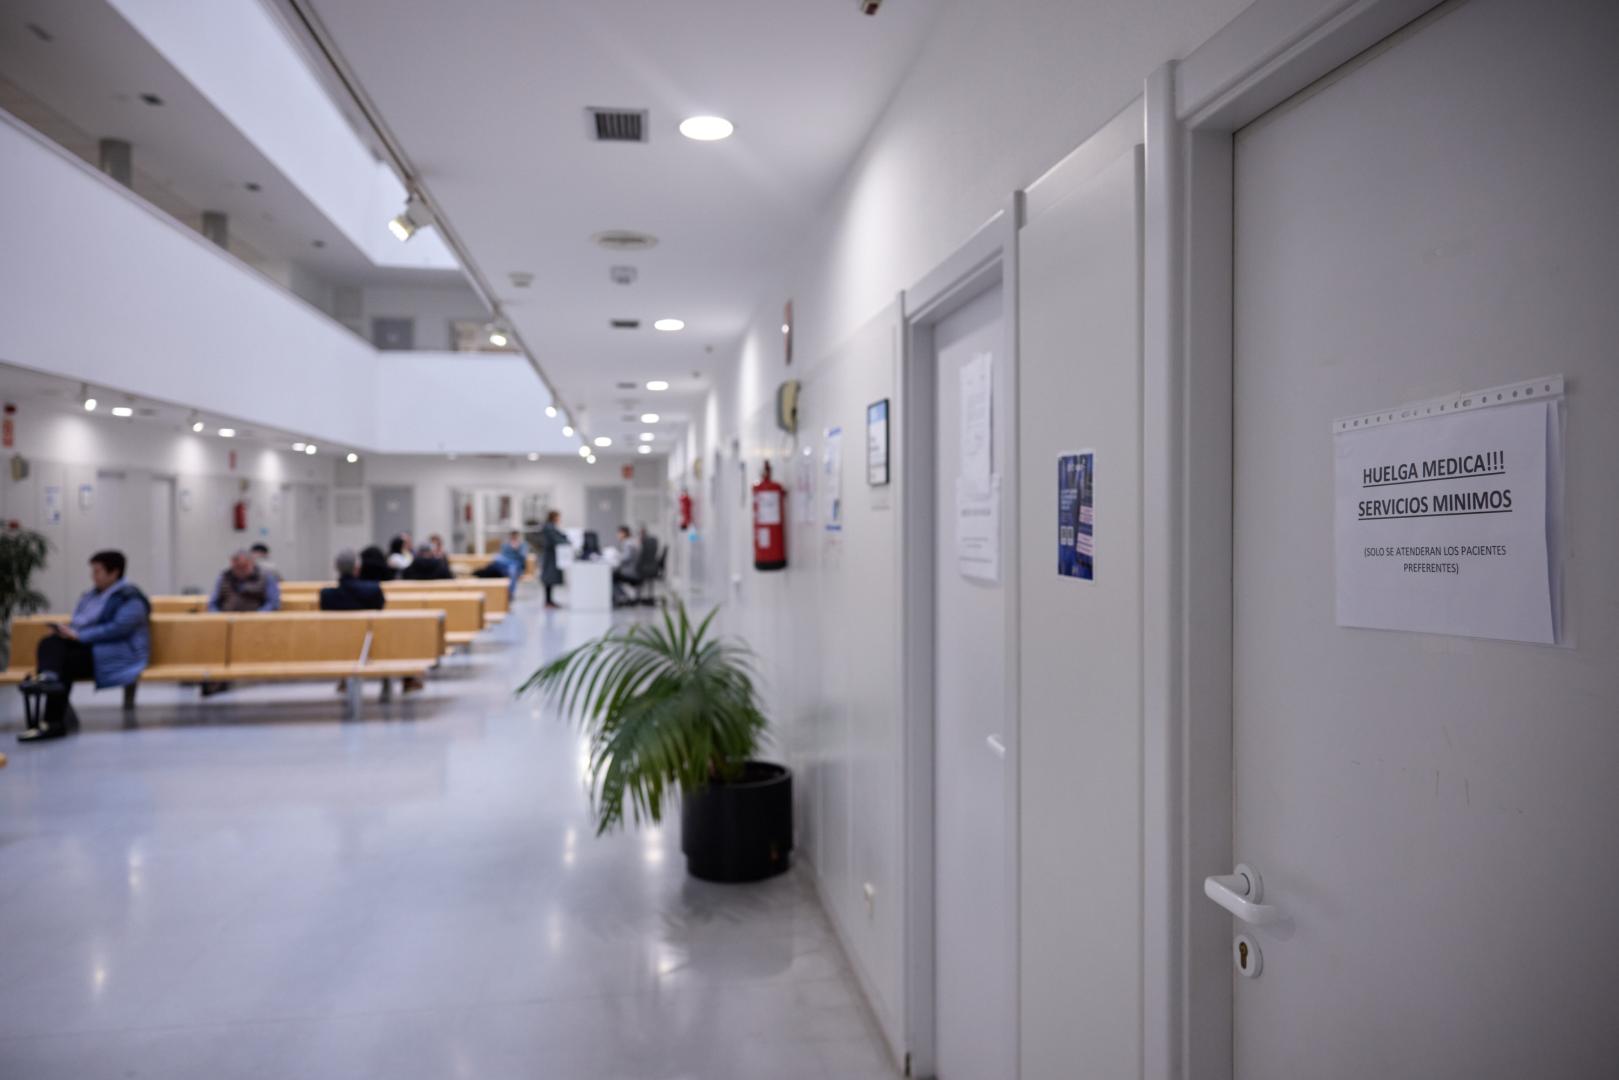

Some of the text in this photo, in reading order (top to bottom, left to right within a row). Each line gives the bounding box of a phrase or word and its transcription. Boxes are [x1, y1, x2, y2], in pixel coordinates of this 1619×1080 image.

[1363, 450, 1505, 484] HUELGA MEDICA!!!
[1358, 489, 1512, 517] SERVICIOS MINIMOS
[1364, 545, 1506, 558] (SOLO SE ATENDERAN LOS PACIENTES
[1403, 563, 1459, 575] PREFERENTES)
